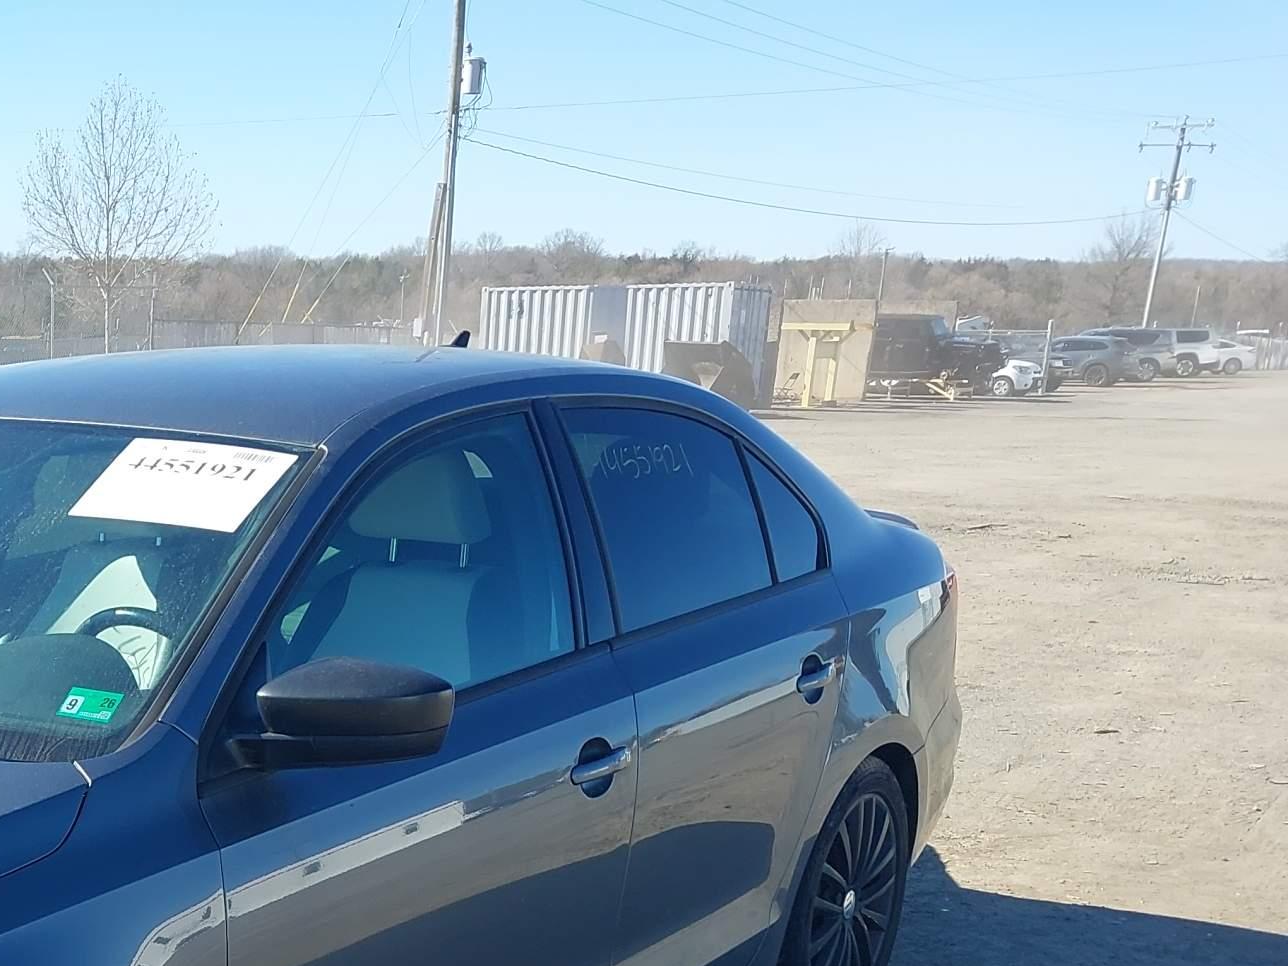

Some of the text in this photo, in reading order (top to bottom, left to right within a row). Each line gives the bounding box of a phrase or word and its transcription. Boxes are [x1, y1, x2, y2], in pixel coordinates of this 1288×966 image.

[128, 456, 257, 481] 44551921
[65, 697, 117, 711] 9 26
